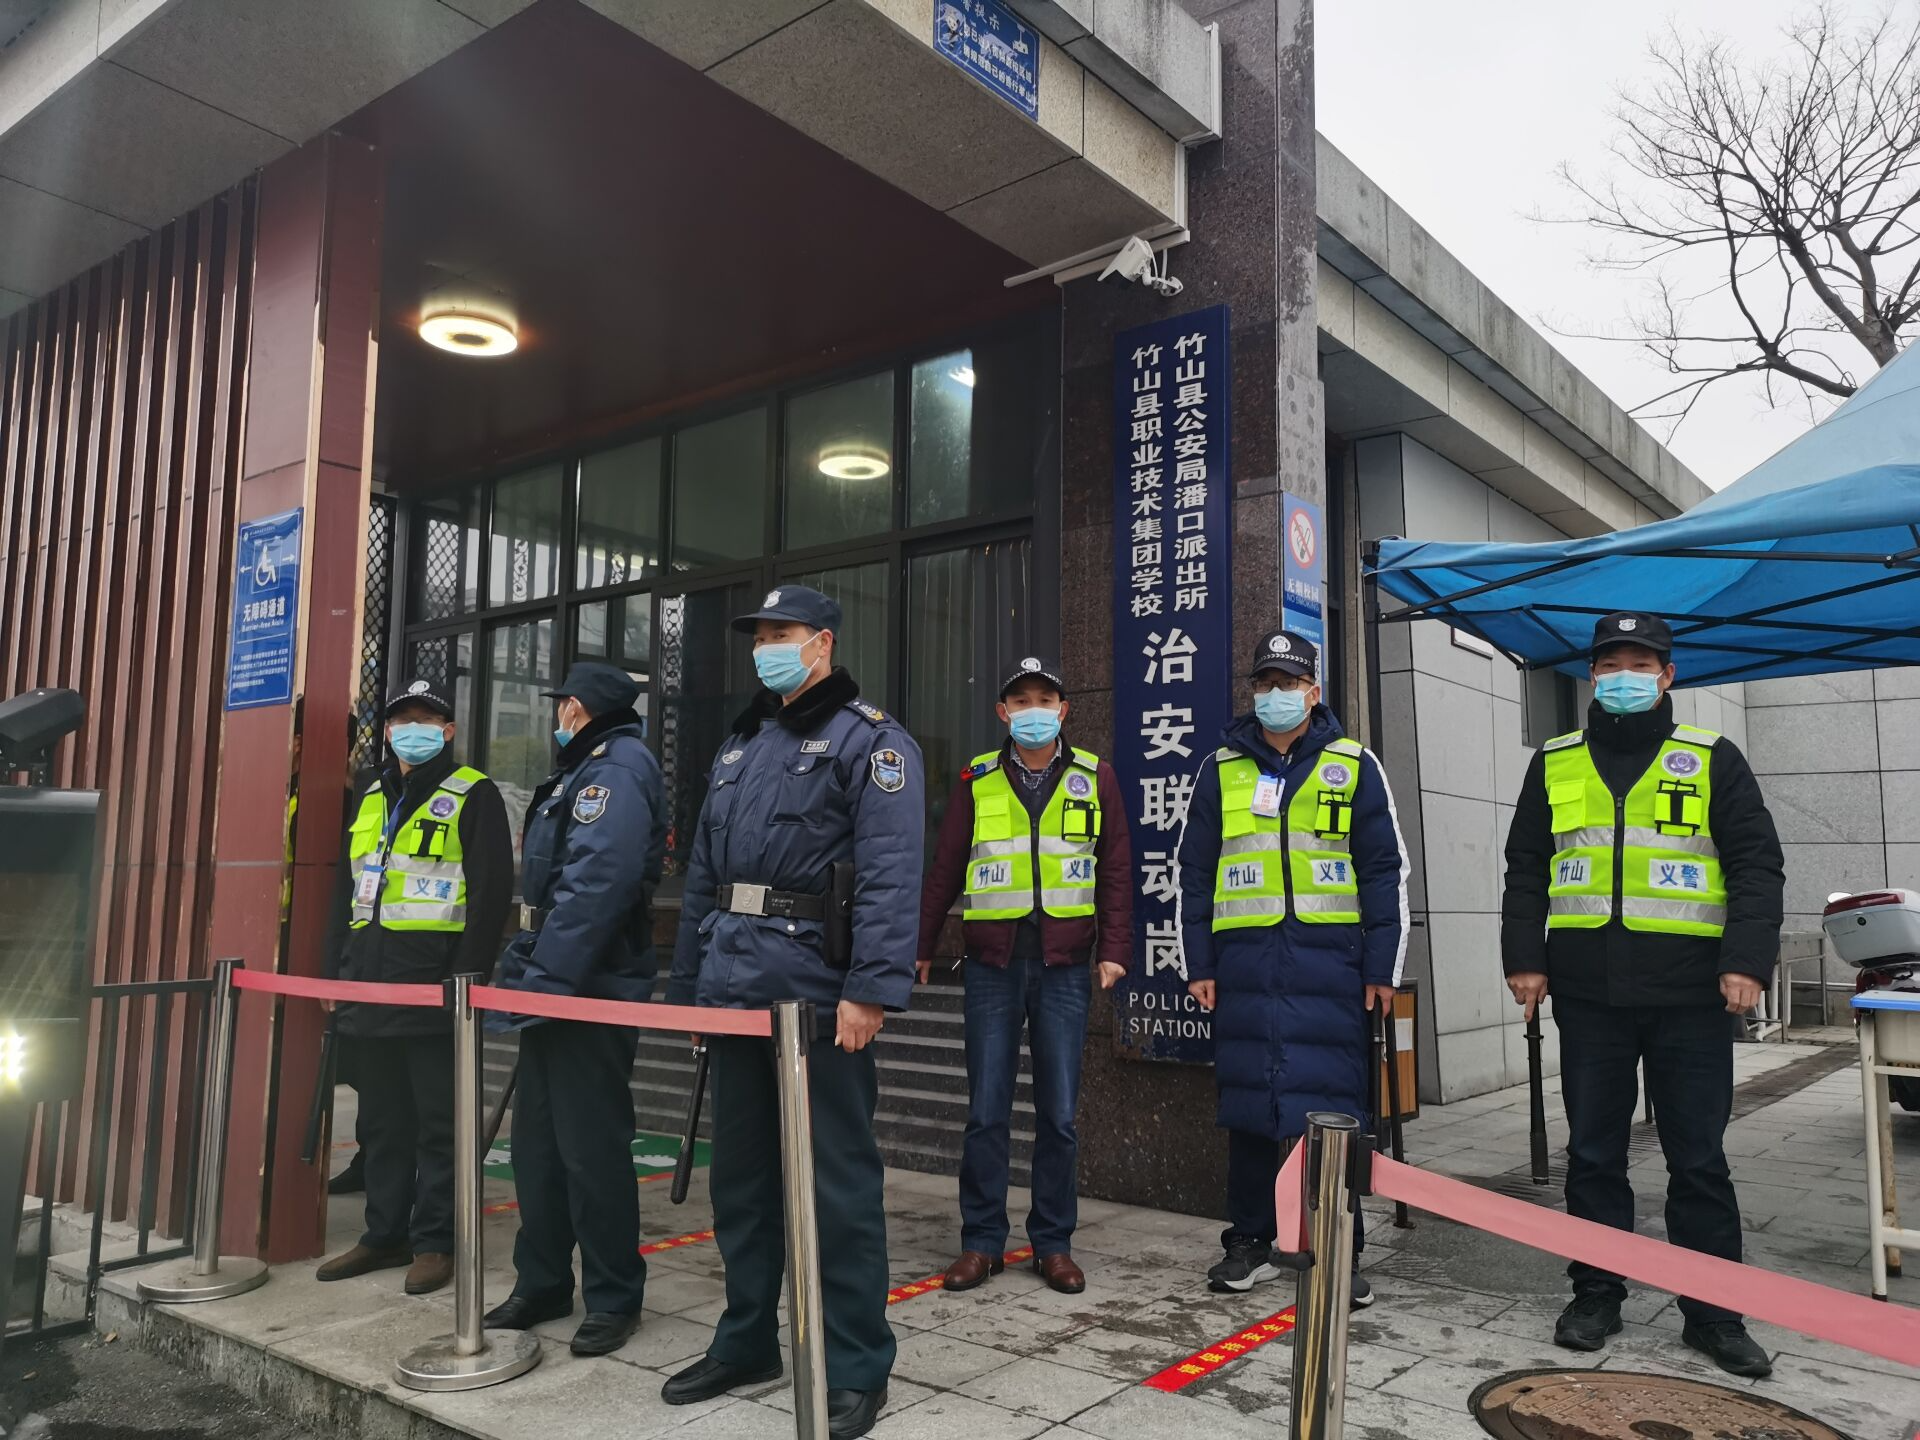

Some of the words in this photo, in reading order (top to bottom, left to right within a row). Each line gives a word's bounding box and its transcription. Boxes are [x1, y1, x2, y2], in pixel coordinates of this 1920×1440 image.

[1131, 343, 1163, 618] 竹山县职业技术集团学校
[1173, 332, 1208, 612] 竹山县公安局潘口派出所
[243, 595, 286, 623] 无障碍通道
[1139, 628, 1198, 978] 治安联动岗
[979, 864, 1005, 885] 竹山
[1228, 865, 1256, 887] 竹山
[1319, 861, 1346, 882] 义警
[1559, 860, 1584, 883] 竹山
[1659, 863, 1699, 889] 义警
[413, 878, 452, 899] 义警
[1129, 1017, 1211, 1040] STATION
